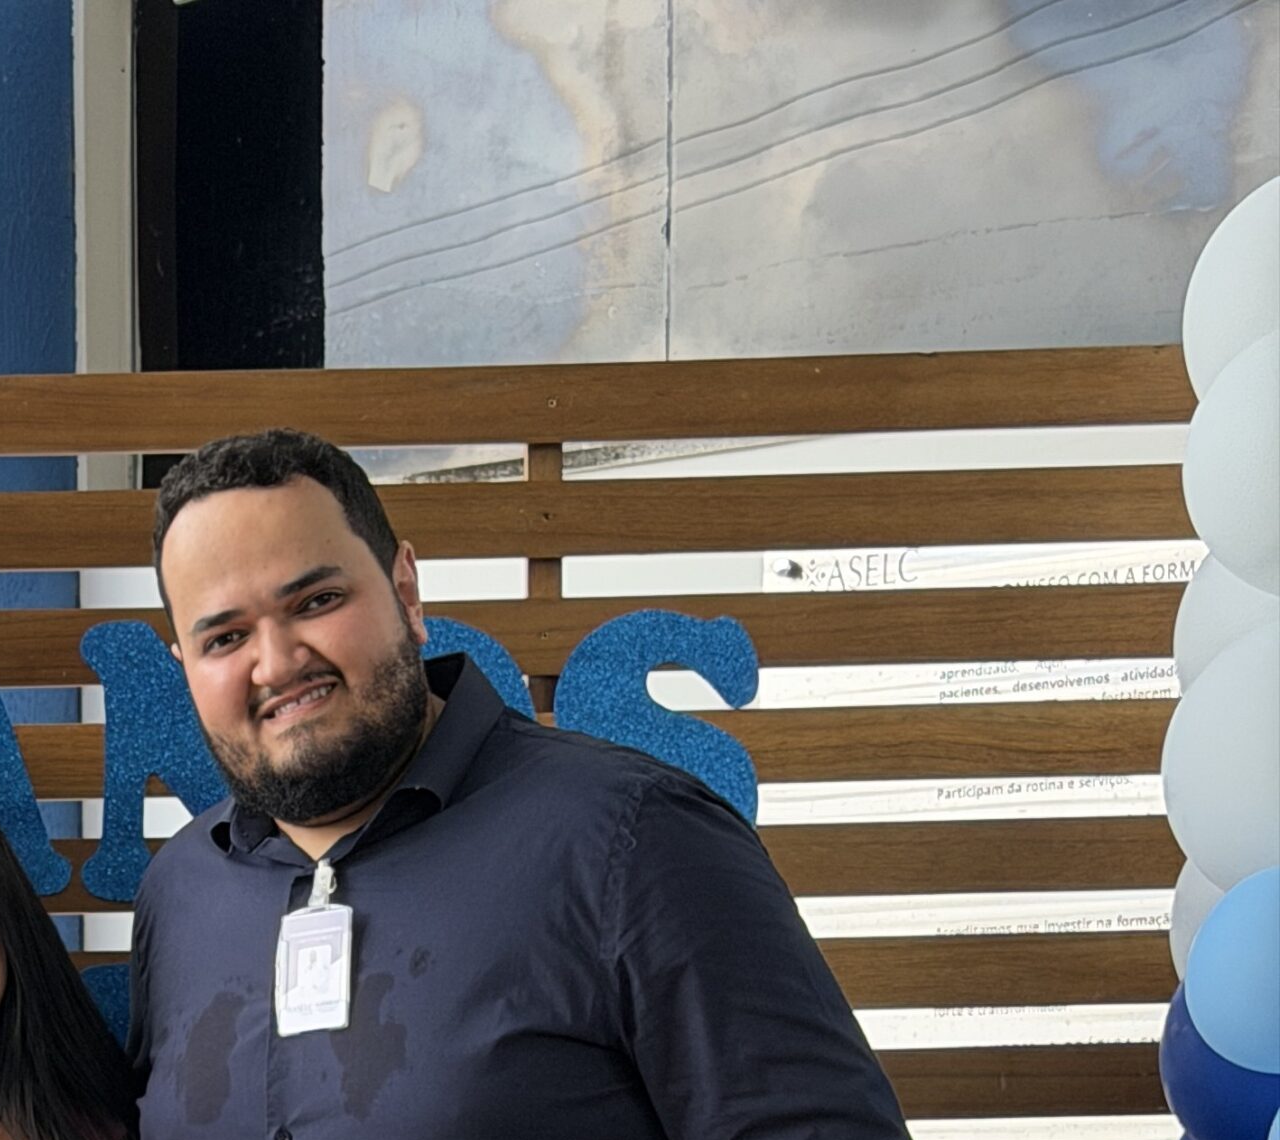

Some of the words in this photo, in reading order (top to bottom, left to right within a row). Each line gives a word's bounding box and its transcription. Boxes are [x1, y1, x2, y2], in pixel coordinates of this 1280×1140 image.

[1124, 567, 1136, 584] A
[1012, 672, 1110, 693] desenvolvemos
[936, 783, 1003, 800] Participam
[1007, 782, 1022, 794] da
[1026, 778, 1063, 793] rotina
[1067, 781, 1075, 789] e
[1097, 919, 1112, 929] na
